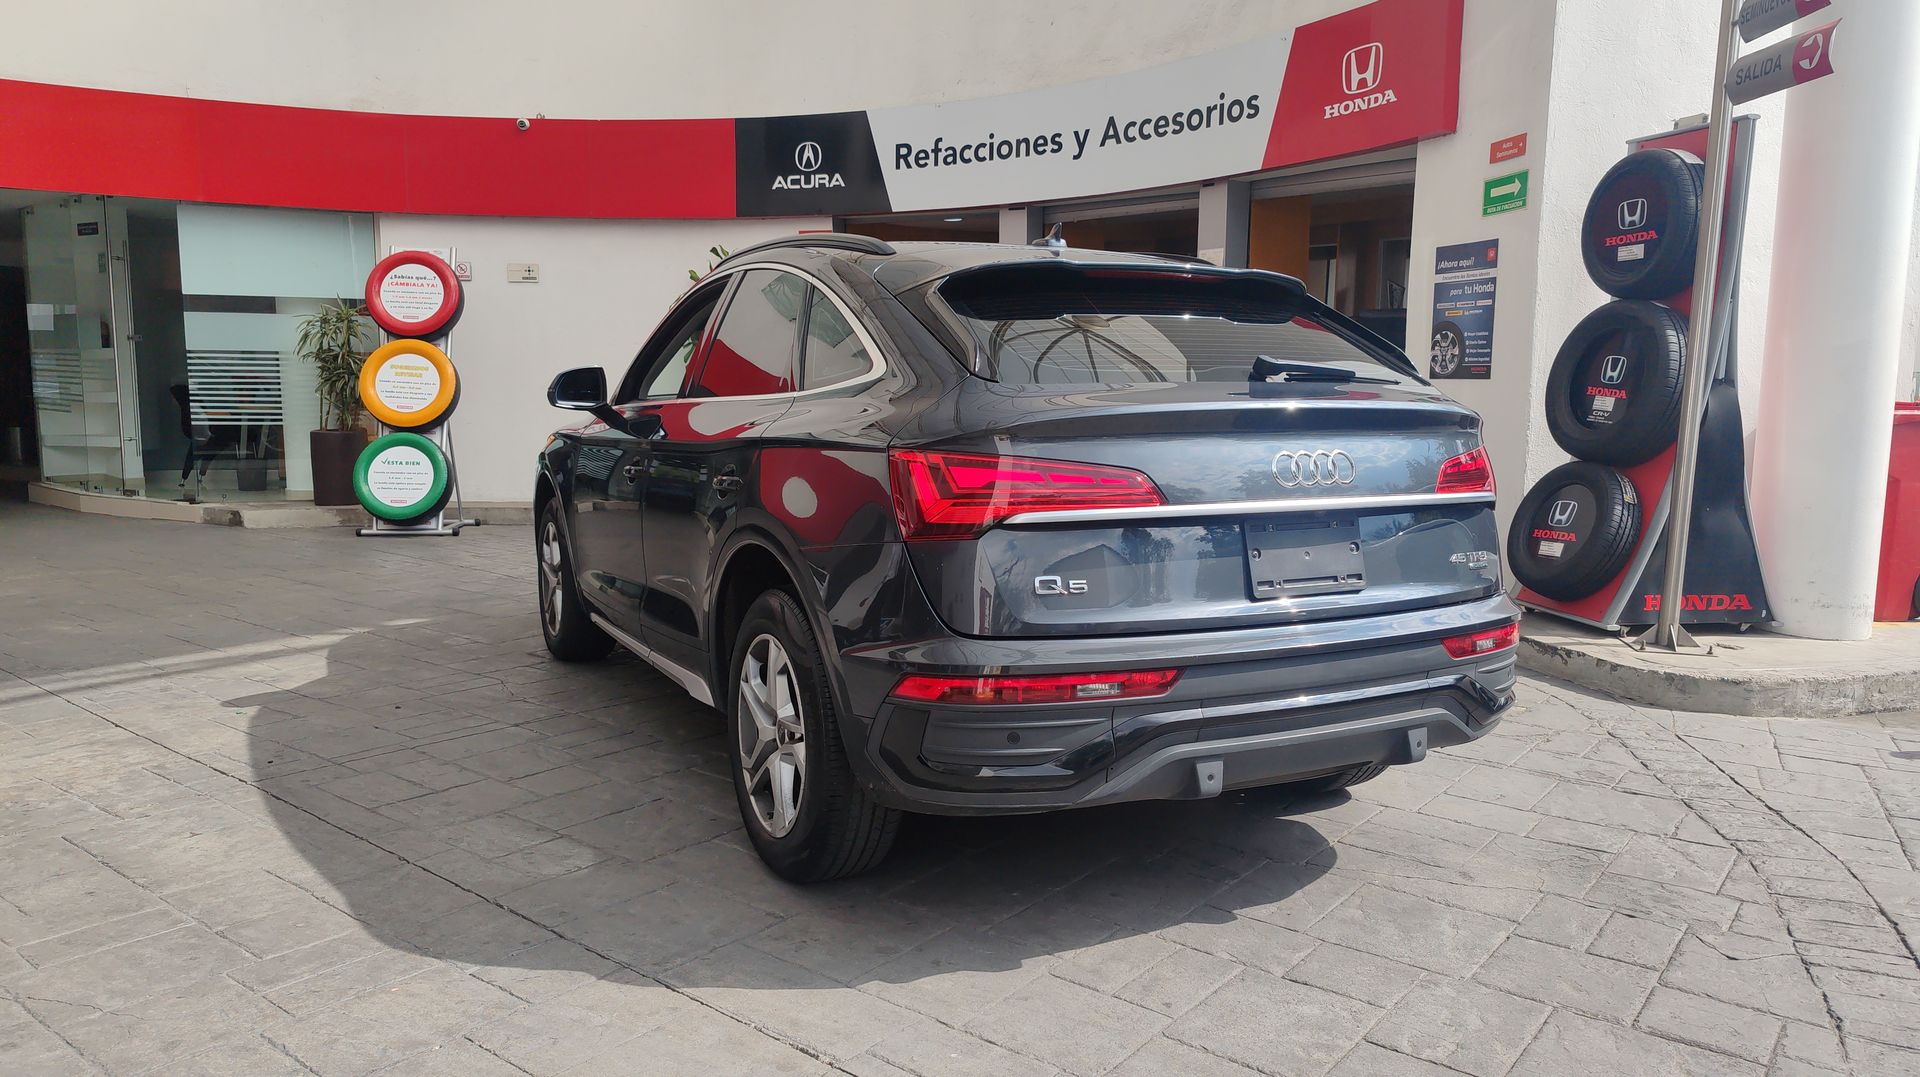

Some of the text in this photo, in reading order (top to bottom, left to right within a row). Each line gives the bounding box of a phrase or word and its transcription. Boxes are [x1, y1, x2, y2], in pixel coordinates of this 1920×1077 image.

[1736, 54, 1782, 86] SALIDA
[1324, 89, 1398, 119] HONDA
[895, 92, 1260, 170] Refacciones y Accesorios
[771, 173, 846, 190] ACURA
[1605, 230, 1658, 246] HONDA
[1450, 282, 1494, 297] para tu Honda
[1587, 386, 1627, 399] HONDA
[1533, 529, 1577, 542] HONDA
[1035, 575, 1088, 595] Q5
[1643, 594, 1752, 611] HNDA
